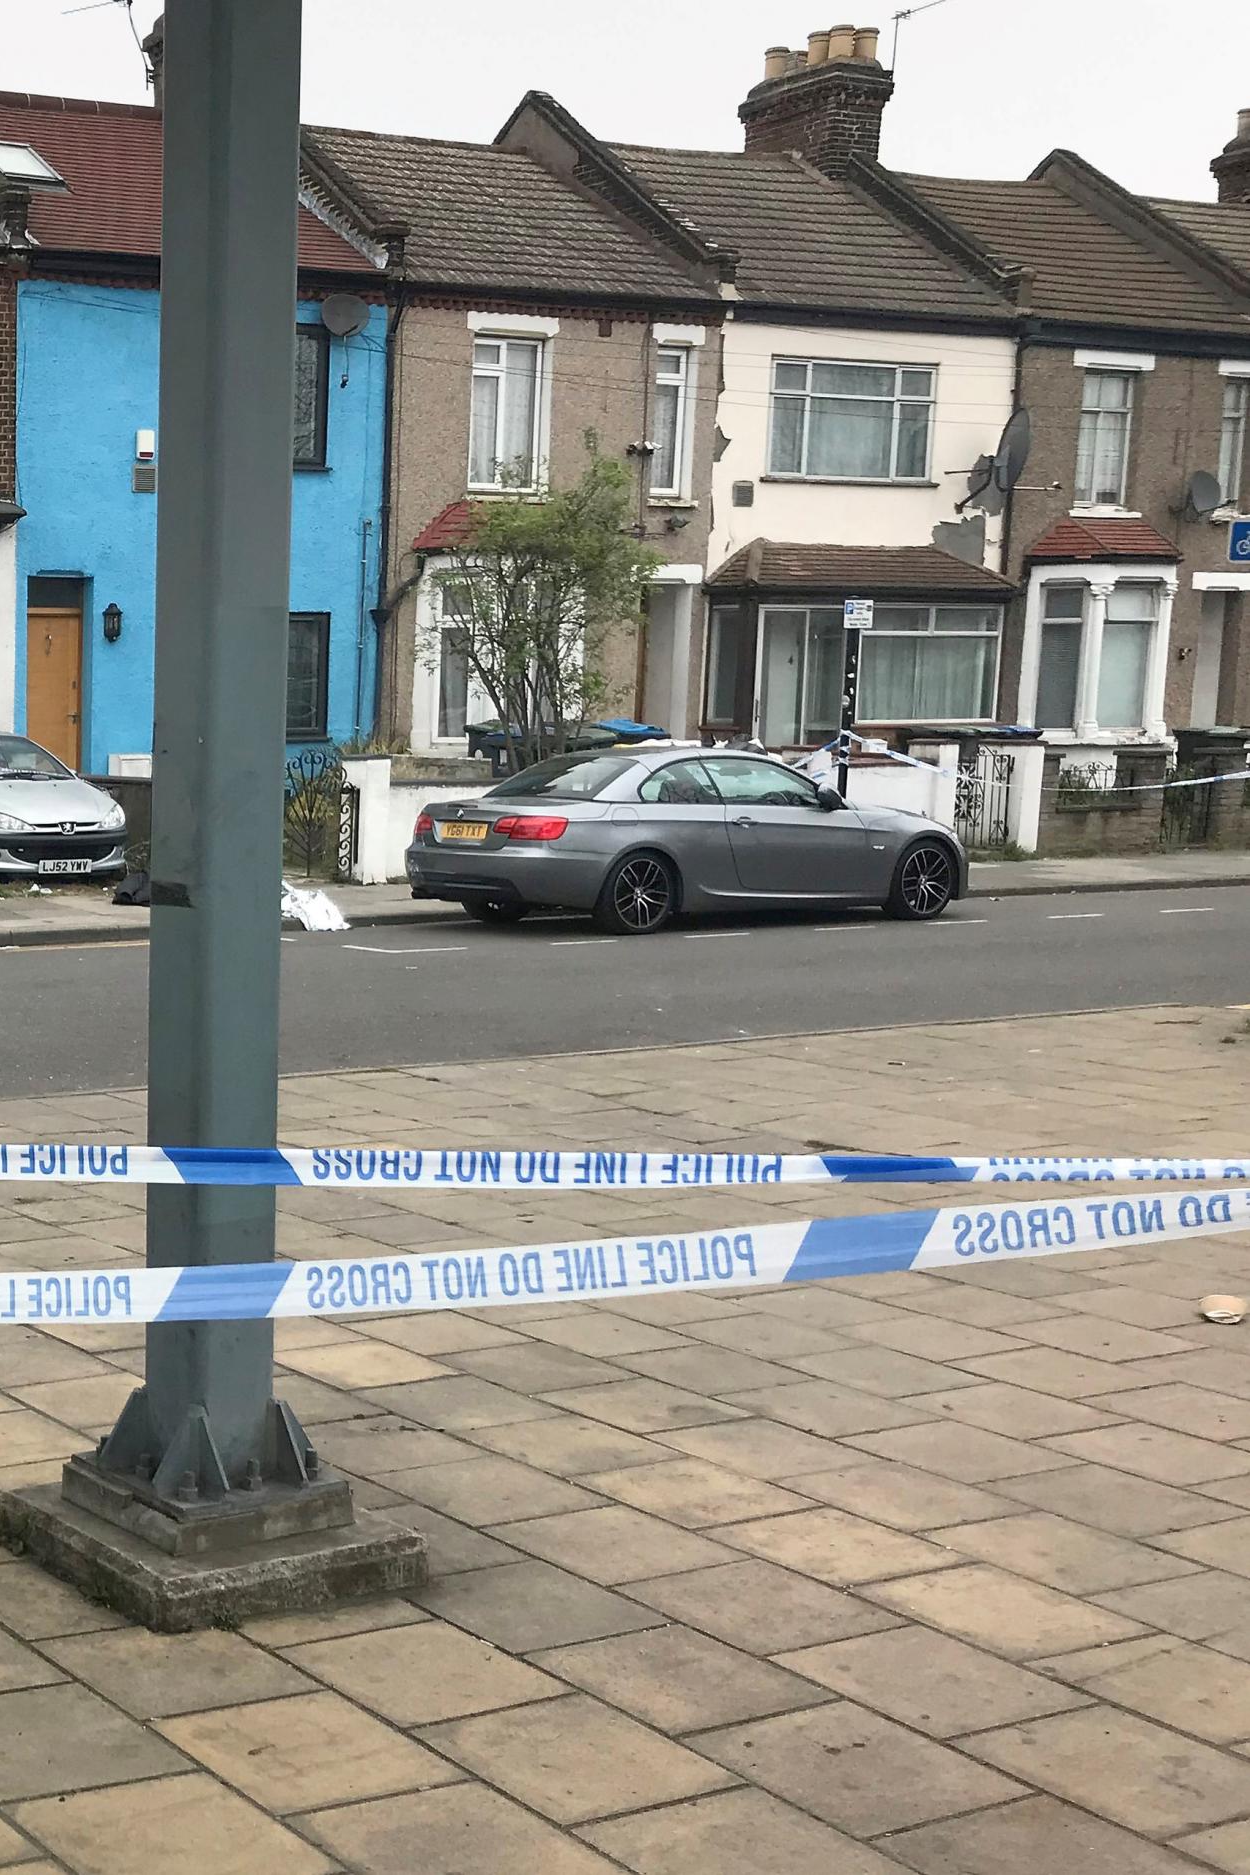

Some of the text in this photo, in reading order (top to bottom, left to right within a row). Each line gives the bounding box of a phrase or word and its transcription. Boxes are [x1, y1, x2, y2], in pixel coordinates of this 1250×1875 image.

[43, 861, 68, 872] LJ52
[20, 1143, 129, 1176] POLICE
[312, 1149, 423, 1181] CROSS
[435, 1150, 500, 1182] NOT
[515, 1151, 561, 1183] DO
